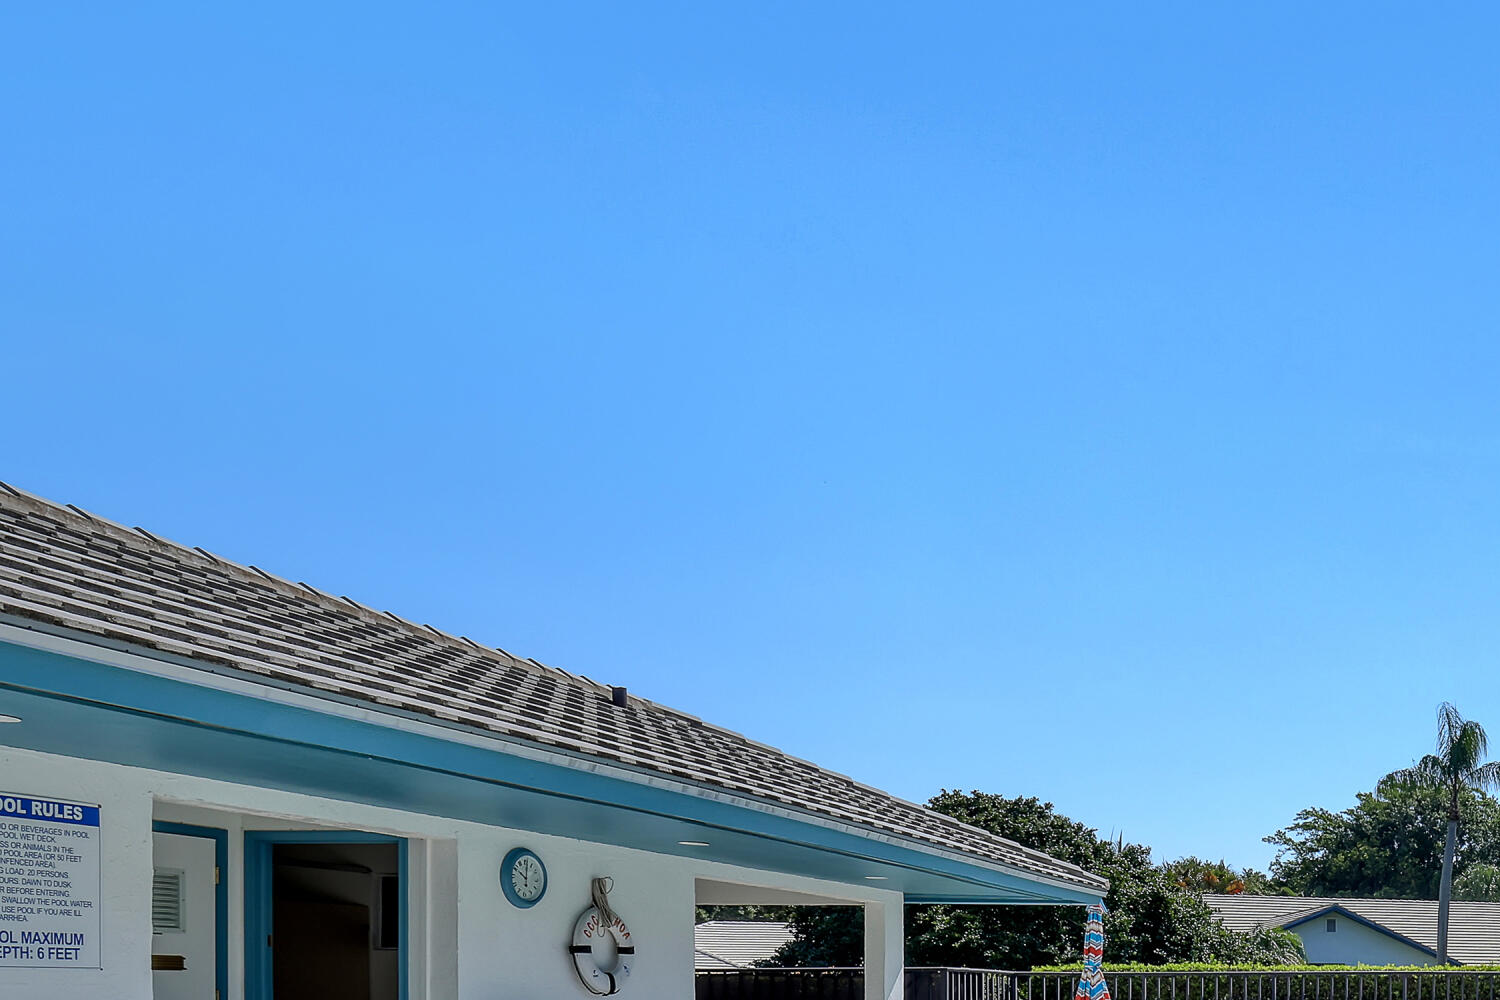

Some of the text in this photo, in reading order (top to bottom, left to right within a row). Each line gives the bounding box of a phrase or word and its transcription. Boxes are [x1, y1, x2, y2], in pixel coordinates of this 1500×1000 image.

[0, 797, 83, 820] OL RULES
[8, 823, 19, 831] OR
[21, 824, 62, 836] BEVERAGES
[64, 829, 70, 837] IN
[72, 830, 90, 839] POOL
[20, 832, 35, 841] WET
[11, 841, 21, 849] OR
[22, 843, 51, 852] ANIMALS
[53, 845, 60, 853] IN
[61, 846, 74, 854] THE
[4, 849, 23, 857] POOL
[24, 851, 42, 859] AREA
[66, 854, 82, 862] FEET
[22, 878, 42, 886] DAWN
[43, 879, 53, 887] TO
[6, 887, 35, 895] BEFORE
[2, 896, 35, 904] SWALLOW
[37, 898, 50, 906] THE
[52, 899, 70, 907] POOL
[17, 906, 36, 914] POOL
[44, 908, 59, 916] YOU
[21, 931, 84, 946] MAXIMUM
[37, 947, 45, 960] 6
[48, 947, 80, 960] FEET
